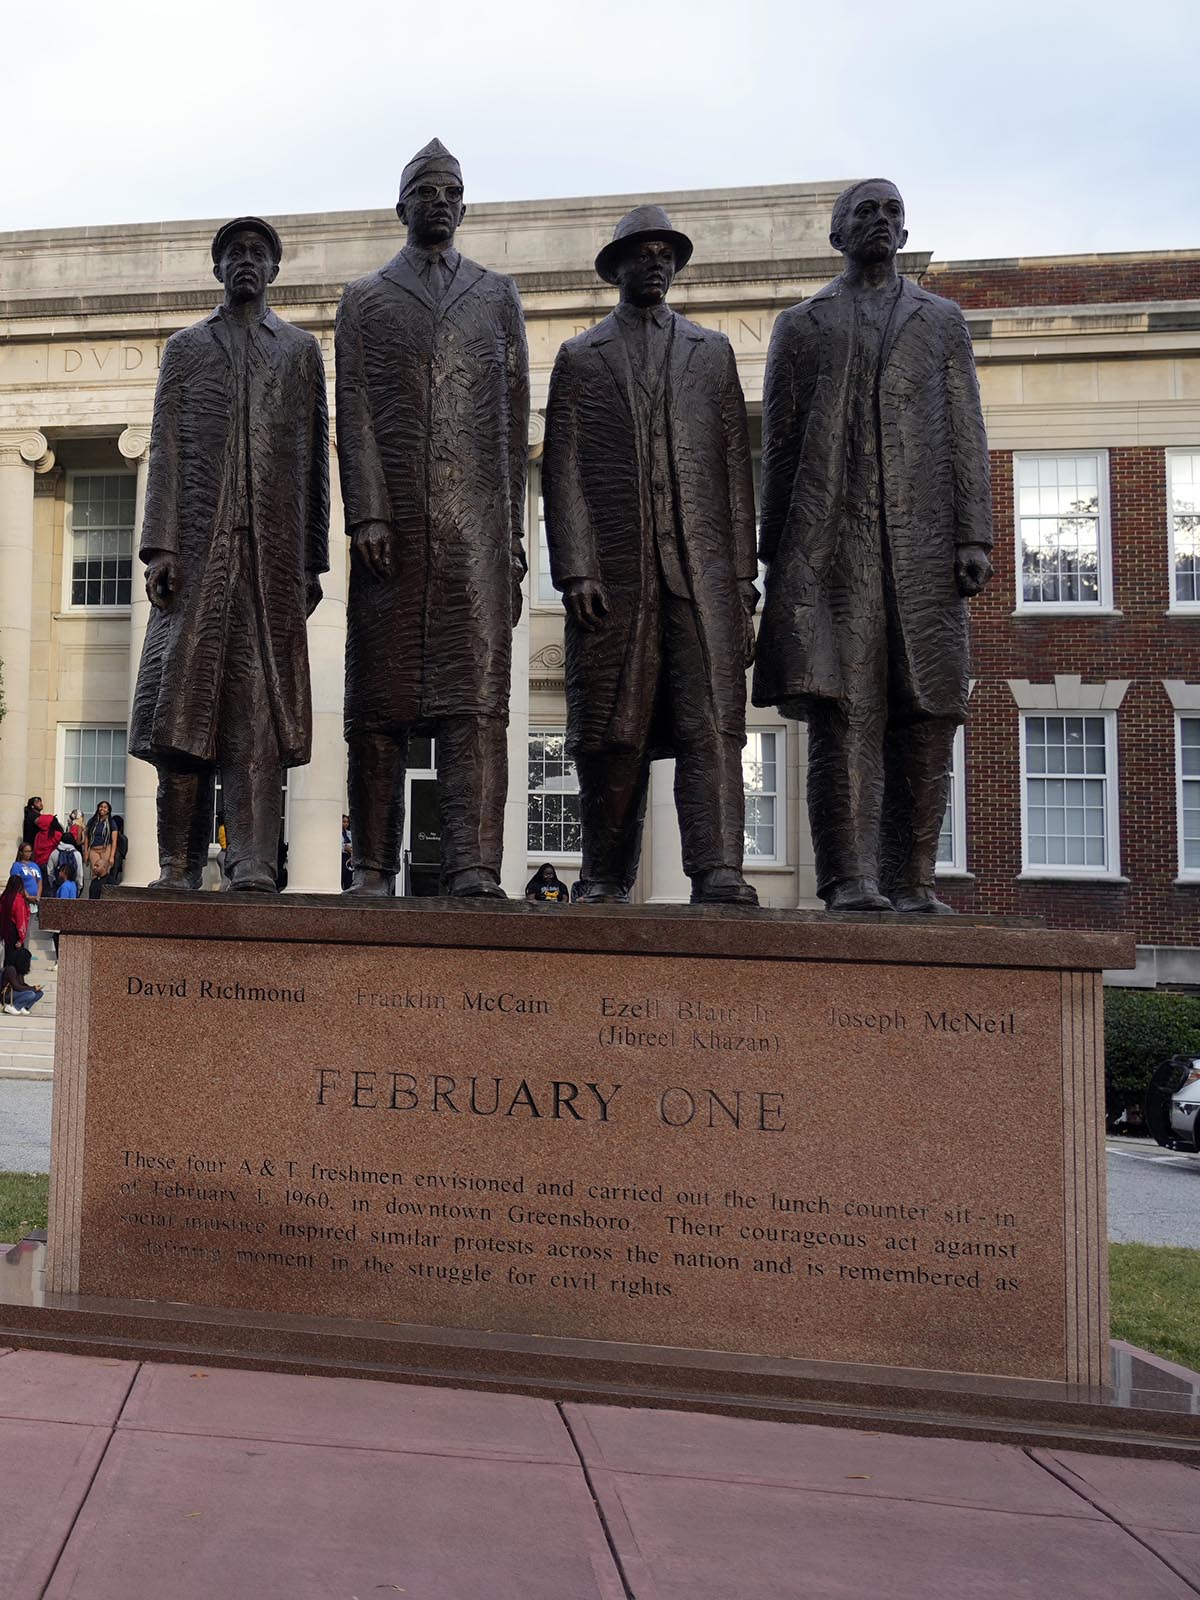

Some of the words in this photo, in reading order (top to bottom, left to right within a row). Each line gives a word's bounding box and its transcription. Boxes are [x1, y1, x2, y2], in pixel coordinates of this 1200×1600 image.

[127, 976, 187, 997] David
[200, 979, 306, 1003] Richmond
[356, 986, 448, 1009] Franklin
[462, 991, 550, 1014] McCain
[601, 997, 659, 1019] Ezell
[598, 1025, 676, 1048] (Jibreel
[692, 1029, 780, 1054] Khazan)
[826, 1007, 906, 1035] Joseph
[924, 1010, 1015, 1035] McNeil
[314, 1068, 622, 1122] FEBRUARY
[658, 1085, 787, 1132] ONE
[121, 1150, 176, 1170] These
[186, 1154, 227, 1174] four
[238, 1158, 252, 1175] A
[260, 1159, 275, 1177] &
[312, 1162, 403, 1185] freshmen
[414, 1171, 525, 1194] envisioned
[537, 1179, 574, 1197] and
[588, 1183, 663, 1203] carried
[677, 1190, 709, 1206] out
[725, 1190, 757, 1209] the
[772, 1192, 830, 1215] lunch
[844, 1201, 929, 1221] counter
[120, 1179, 141, 1196] of
[150, 1180, 241, 1202] February
[352, 1194, 370, 1212] in
[385, 1197, 492, 1221] downtown
[508, 1205, 637, 1232] Greensboro.
[664, 1216, 725, 1237] Their
[740, 1225, 867, 1249] courageous
[885, 1235, 917, 1251] act
[934, 1237, 1017, 1260] against
[120, 1211, 174, 1227] social
[184, 1214, 267, 1235] injustice
[279, 1221, 357, 1243] inspired
[370, 1226, 442, 1248] similar
[454, 1236, 534, 1255] protests
[548, 1243, 613, 1260] across
[627, 1245, 659, 1264] the
[674, 1251, 740, 1270] nation
[753, 1256, 792, 1274] and
[807, 1258, 824, 1276] is
[839, 1264, 980, 1289] remembered
[995, 1276, 1019, 1291] as
[236, 1249, 314, 1269] moment
[331, 1254, 349, 1270] in
[365, 1255, 395, 1274] the
[408, 1263, 492, 1286] struggle
[507, 1266, 537, 1286] for
[550, 1270, 596, 1290] civil
[611, 1275, 678, 1299] rights.
